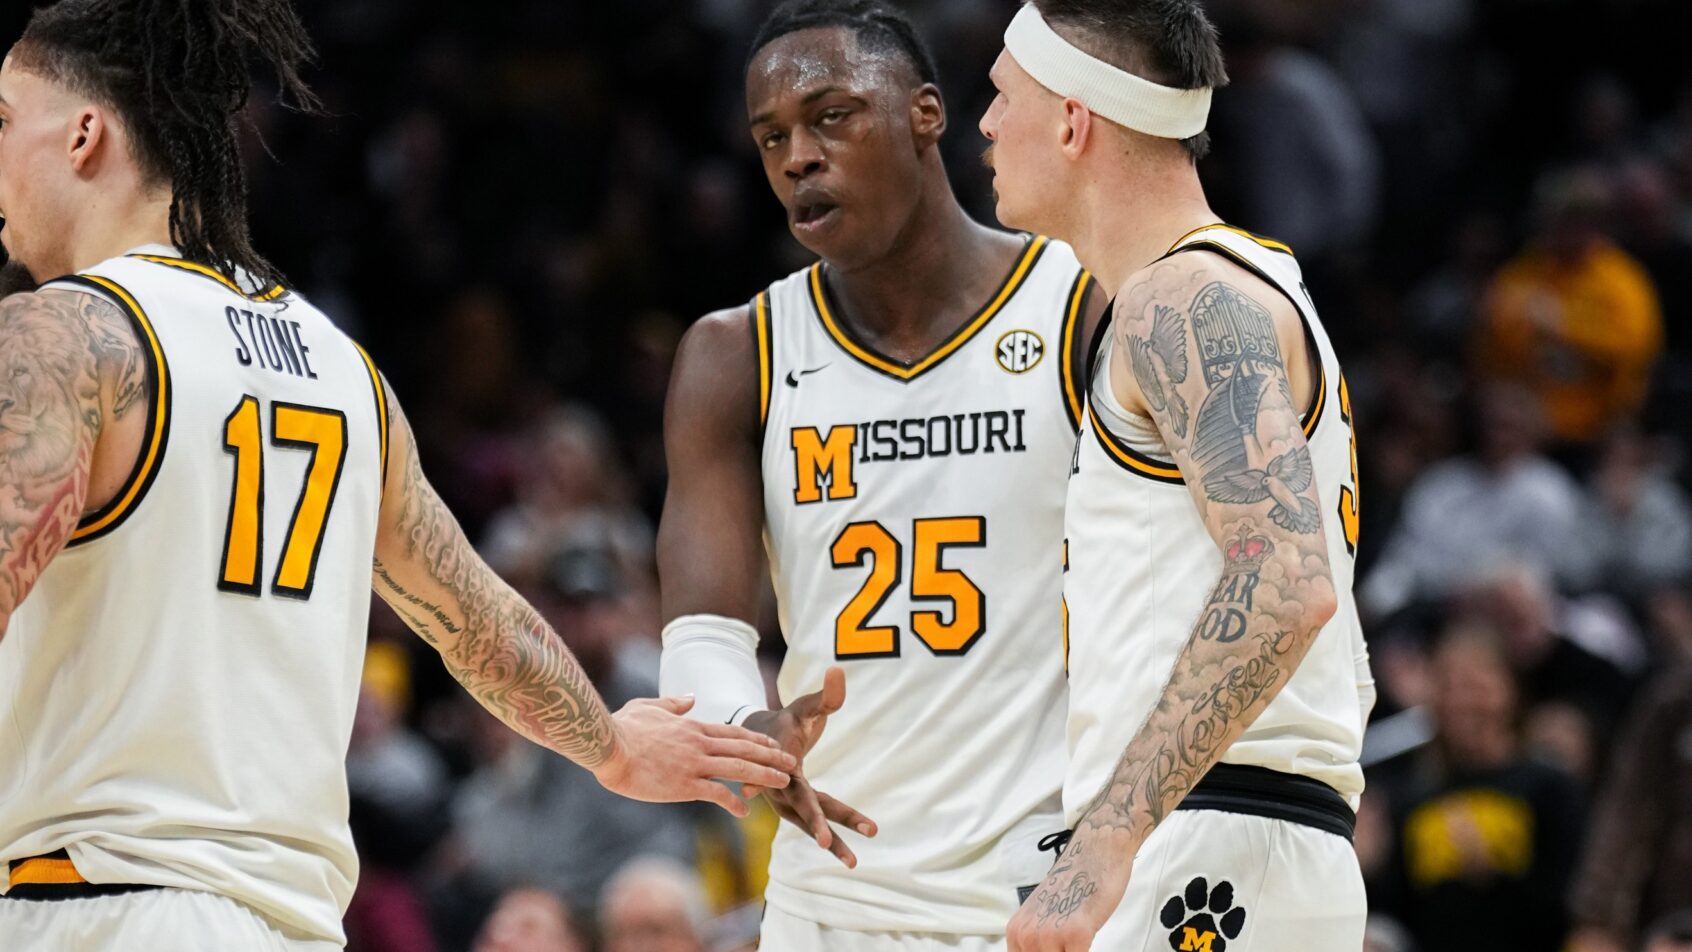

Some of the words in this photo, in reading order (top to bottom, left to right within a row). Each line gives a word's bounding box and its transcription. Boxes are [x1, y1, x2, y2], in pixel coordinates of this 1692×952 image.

[224, 305, 318, 380] STONE
[997, 331, 1042, 372] SEC
[790, 409, 1026, 506] MISSOURI
[217, 393, 348, 601] 17
[829, 516, 986, 661] 25
[1209, 572, 1260, 613] EAR
[1189, 607, 1247, 643] OD
[1178, 926, 1217, 952] M
